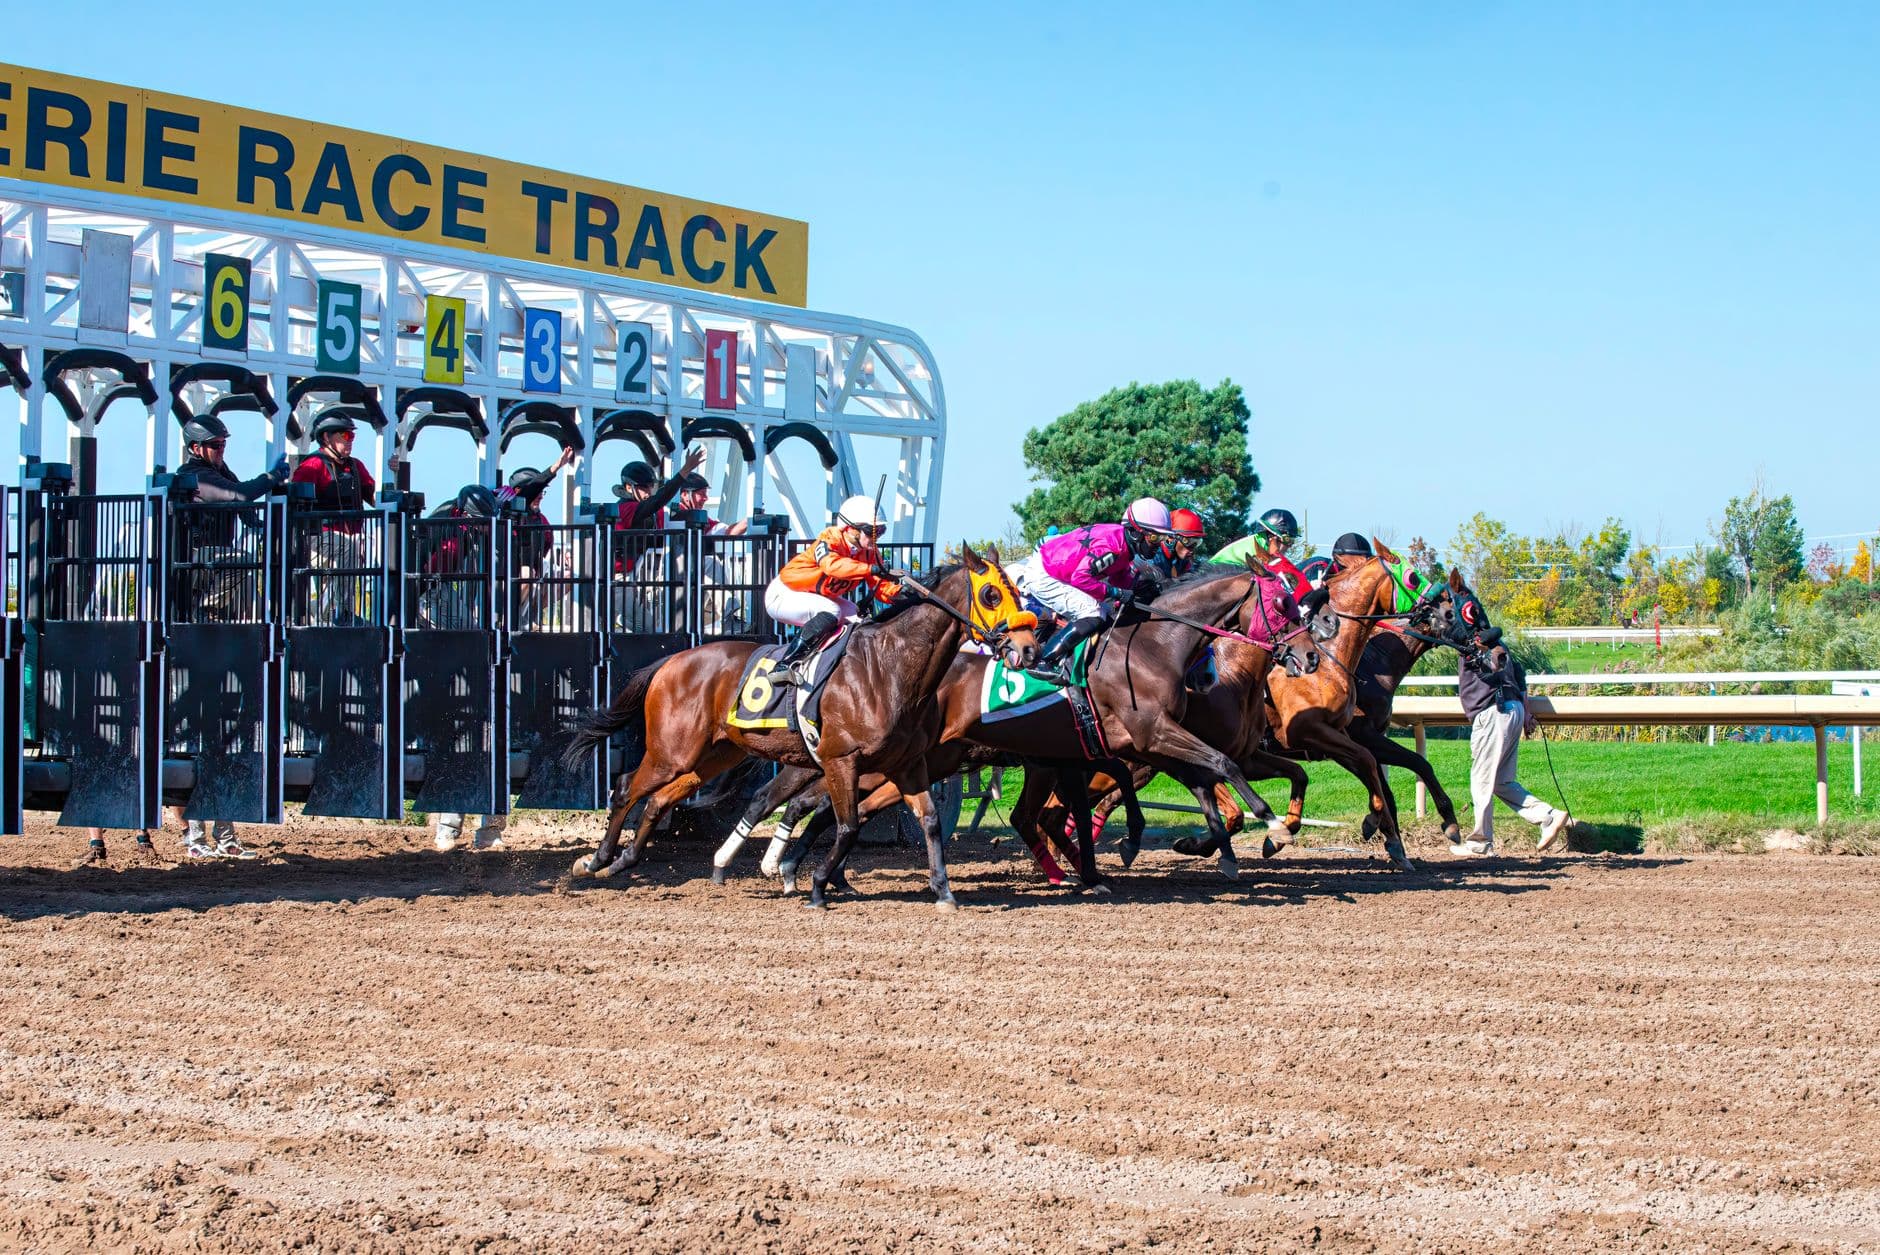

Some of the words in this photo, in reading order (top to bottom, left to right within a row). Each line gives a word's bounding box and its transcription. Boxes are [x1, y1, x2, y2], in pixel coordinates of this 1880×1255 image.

[0, 82, 199, 195] RIE
[237, 126, 487, 243] RACE
[522, 180, 778, 295] TRACK
[212, 266, 243, 339] 6
[324, 292, 354, 362] 5
[430, 308, 459, 373] 4
[530, 318, 556, 383] 3
[623, 332, 648, 393] 2
[713, 339, 728, 399] 1
[1095, 552, 1114, 573] 5
[742, 657, 777, 713] 6
